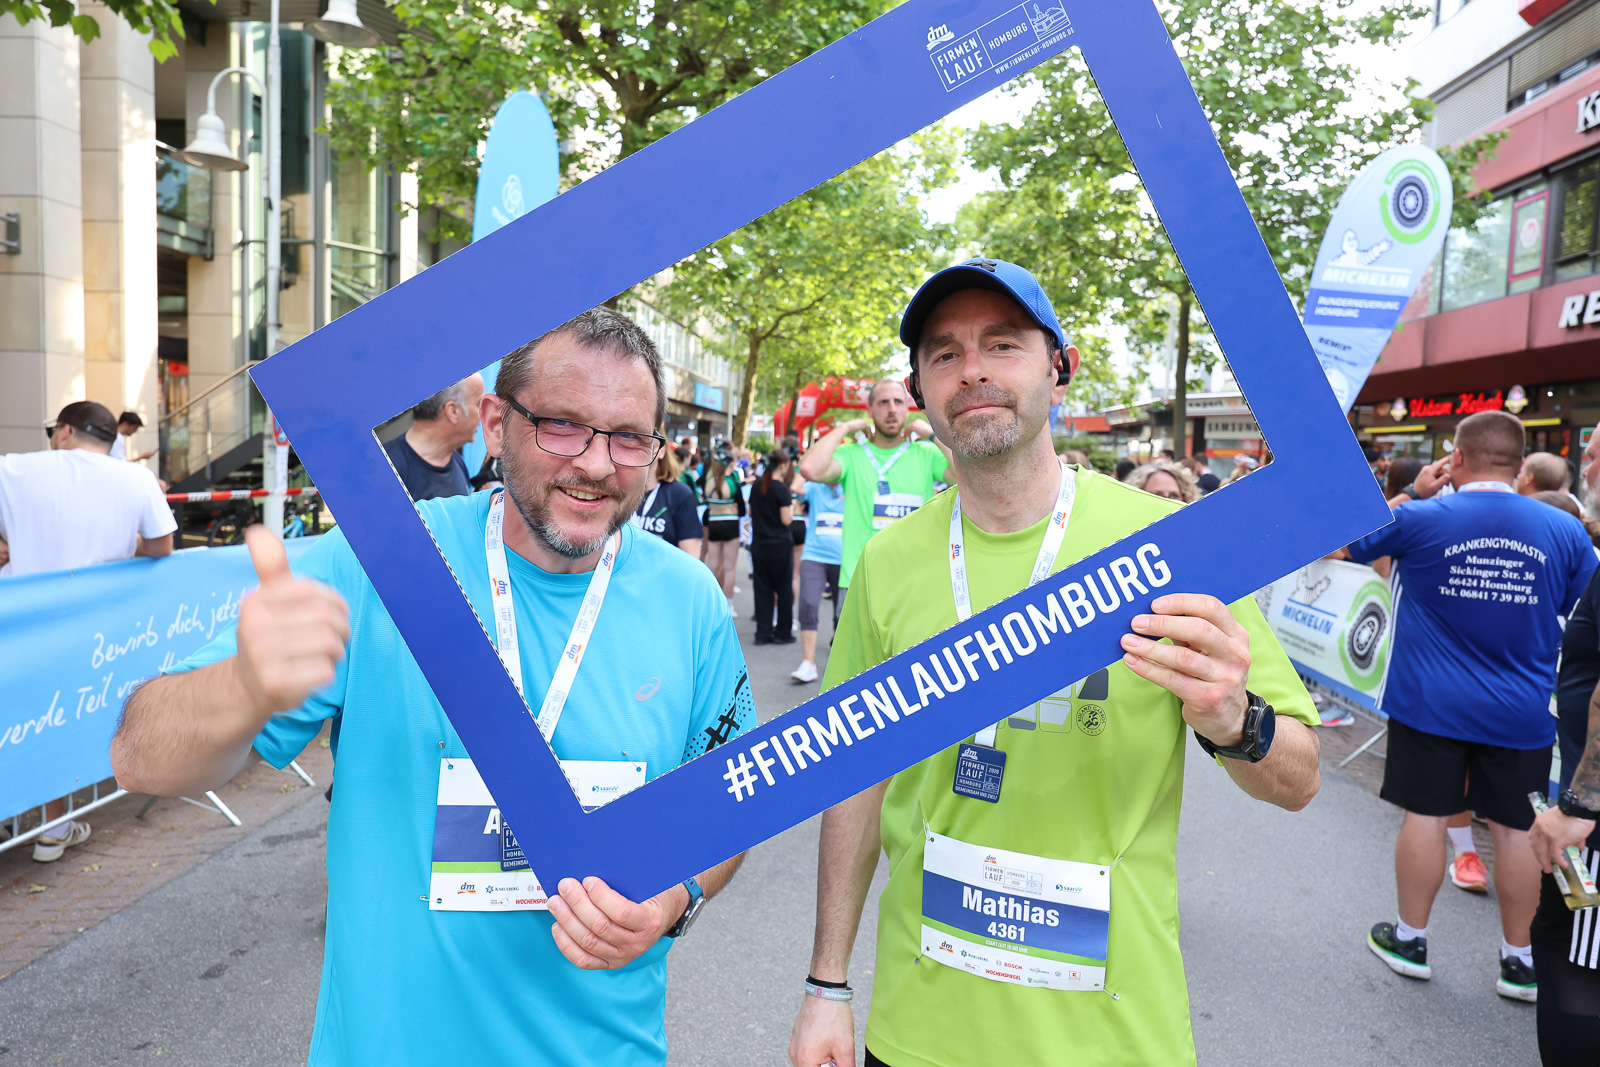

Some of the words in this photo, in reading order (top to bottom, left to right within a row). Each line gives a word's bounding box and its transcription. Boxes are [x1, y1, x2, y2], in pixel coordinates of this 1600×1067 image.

[927, 23, 949, 43] dm
[988, 22, 1028, 50] HOMBURG
[937, 37, 978, 67] FIRMEN
[994, 27, 1075, 75] WWW.FIRMENLAUF-HOMBURG.DE
[943, 50, 985, 85] LAUF
[1321, 267, 1411, 288] MICHELIN
[1053, 511, 1064, 525] dm
[954, 544, 962, 557] dm
[1444, 537, 1547, 566] KRANKENGYMNASTIK
[602, 552, 611, 567] dm
[1465, 555, 1525, 569] Munzinger
[1449, 565, 1501, 579] Sickinger
[1502, 569, 1521, 580] Str.
[1523, 571, 1536, 581] 36
[498, 580, 508, 594] dm
[1448, 577, 1478, 588] 66424
[1479, 579, 1533, 595] Homburg
[1438, 585, 1458, 597] Tel.
[1460, 588, 1488, 600] 06841
[1491, 591, 1498, 601] 7
[1499, 592, 1512, 602] 39
[1513, 594, 1527, 604] 89
[1282, 605, 1334, 635] MICHELIN
[91, 615, 159, 669] Bewirb
[166, 603, 205, 639] dich
[566, 644, 579, 660] dm
[722, 542, 1172, 802] #FIRMENLAUFHOMBURG
[75, 672, 114, 720] Teil
[964, 748, 977, 757] dm
[962, 760, 985, 770] FIRMEN
[960, 767, 984, 779] LAUF
[959, 778, 982, 788] HOMBURG
[955, 785, 980, 796] GEMEINSAM
[506, 838, 519, 848] LA
[506, 850, 524, 858] HOMBU
[503, 860, 529, 868] GEMEINSA
[985, 866, 1004, 874] FIRMEN
[984, 872, 1003, 882] LAUF
[460, 882, 475, 890] dm
[962, 885, 1060, 927] Mathias
[987, 921, 1026, 942] 4361
[941, 941, 953, 950] dm
[1003, 962, 1023, 970] BOSCH
[985, 968, 1021, 981] WOCHENSPIEGEL
